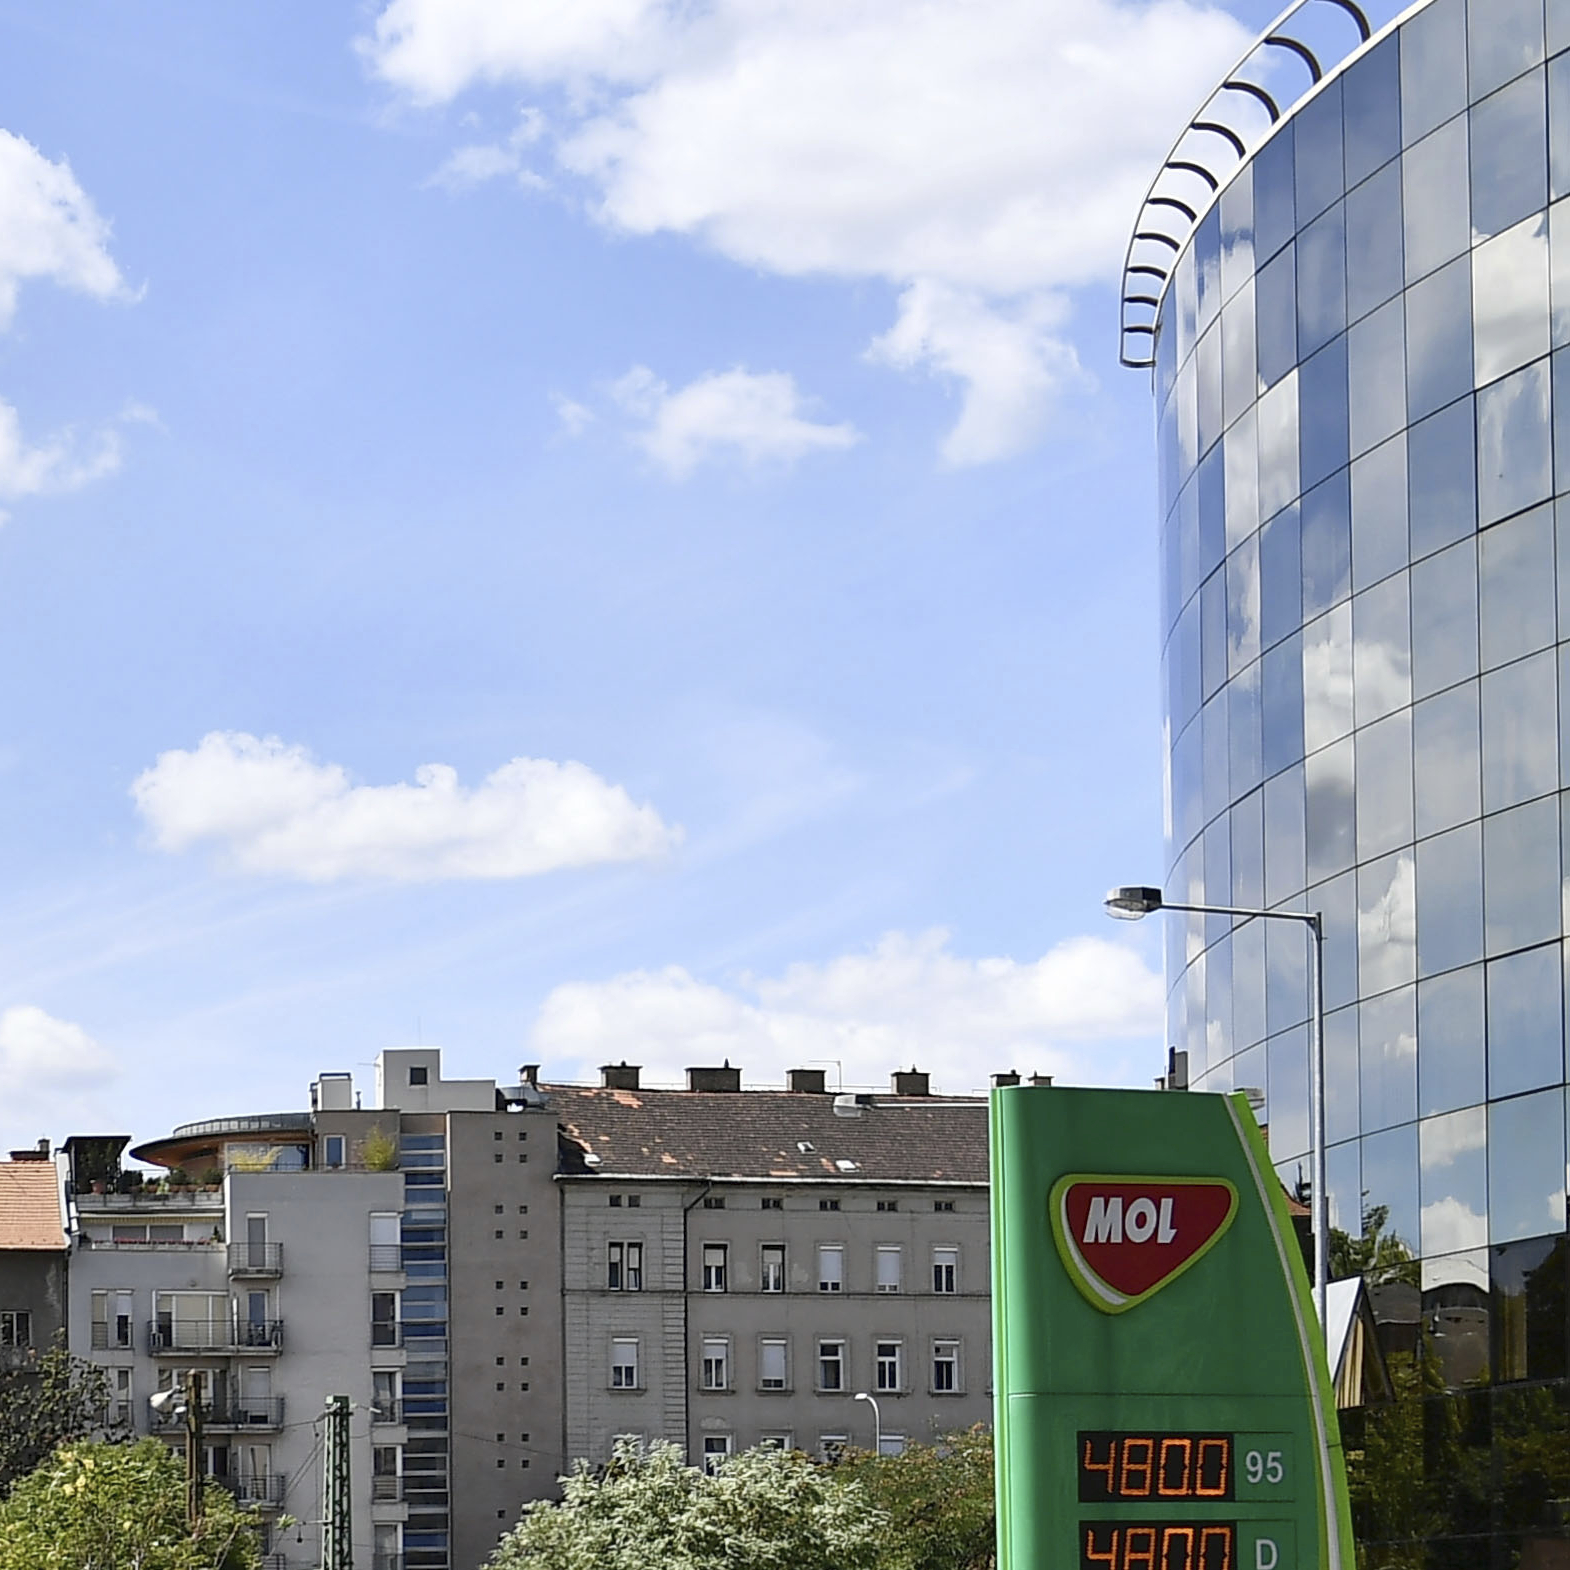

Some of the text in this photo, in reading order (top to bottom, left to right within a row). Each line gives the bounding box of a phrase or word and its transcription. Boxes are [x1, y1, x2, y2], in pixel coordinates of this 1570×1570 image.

[1084, 1197, 1178, 1246] MOL
[1245, 1451, 1283, 1483] 95
[1255, 1539, 1278, 1570] D
